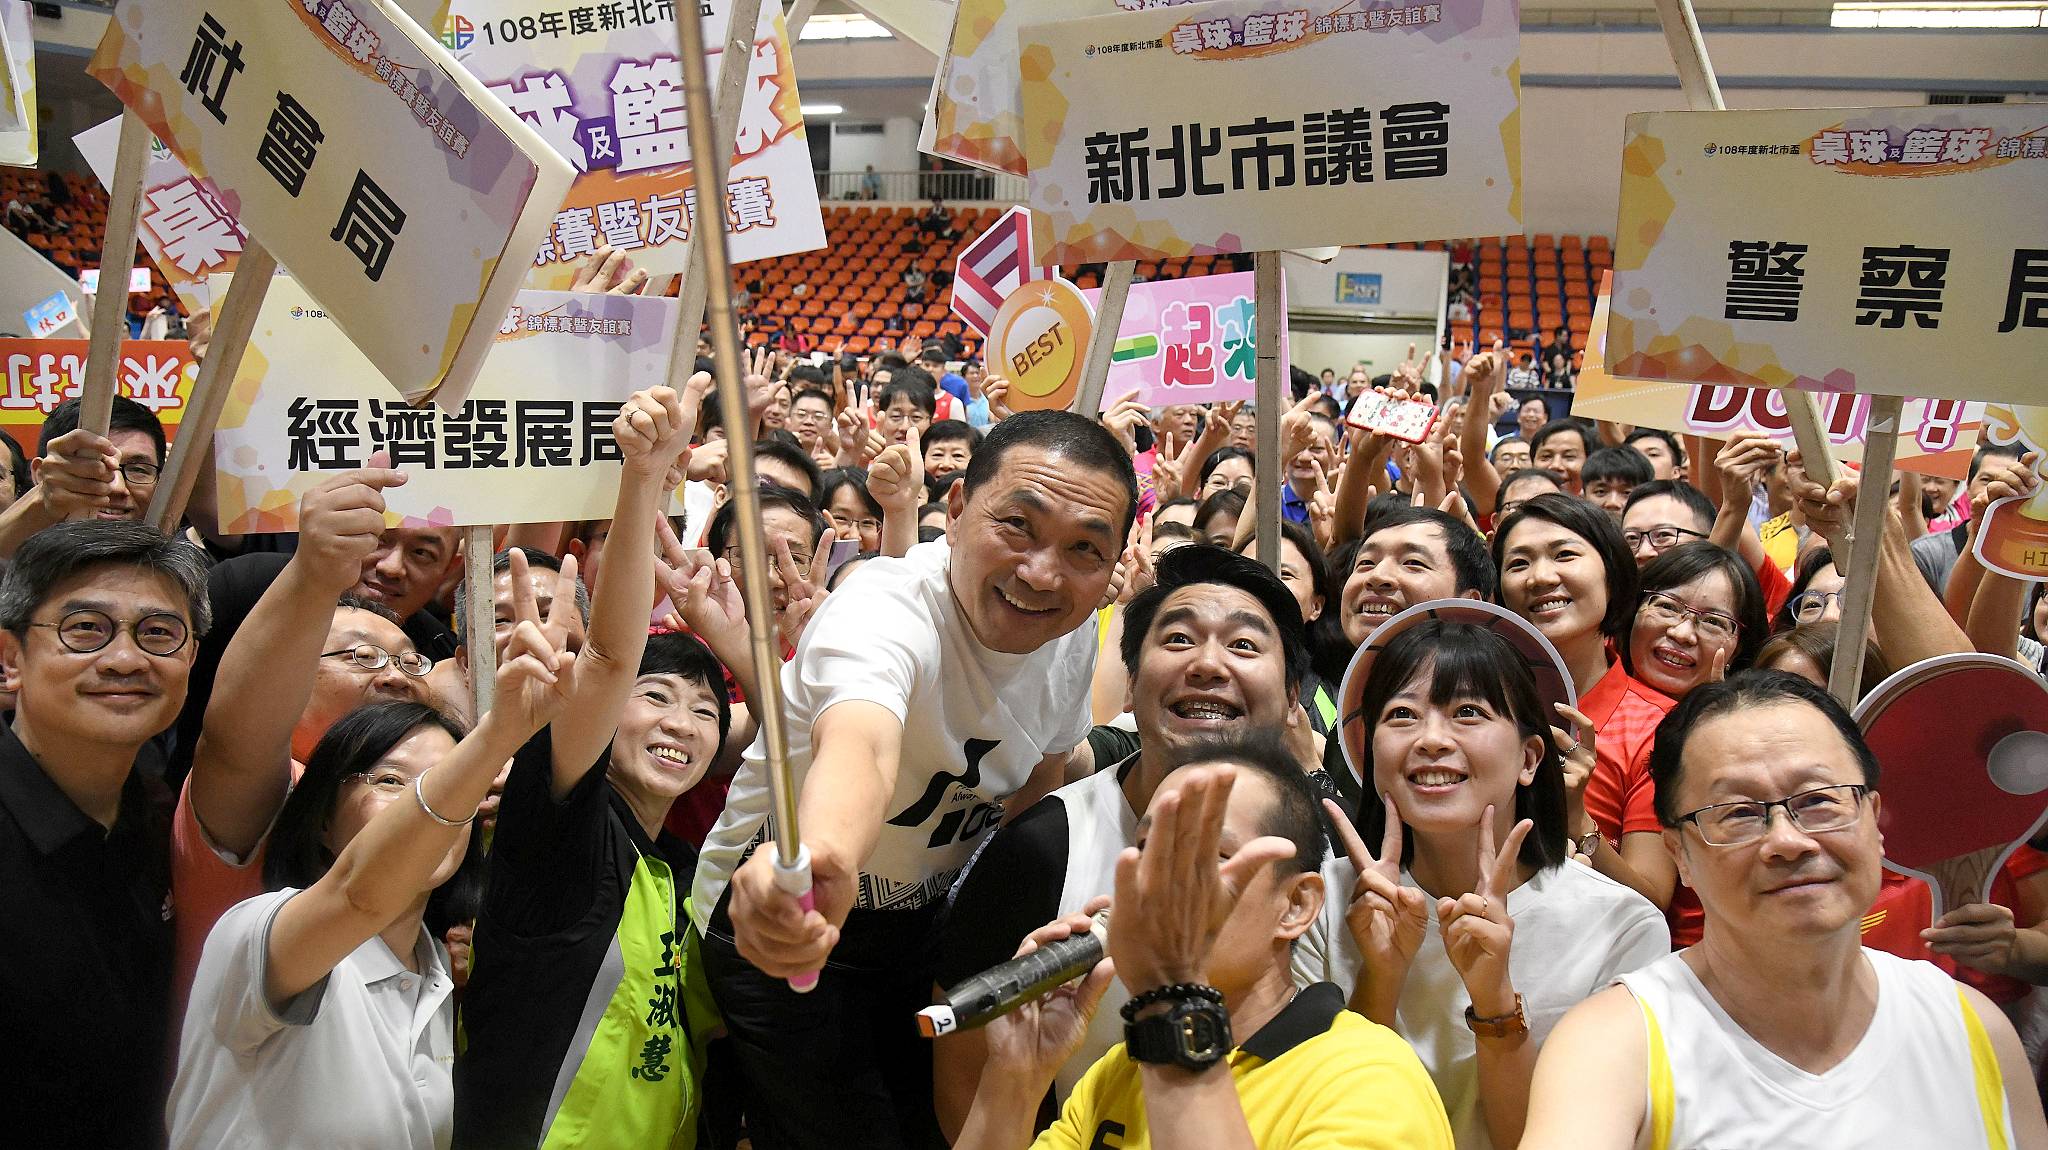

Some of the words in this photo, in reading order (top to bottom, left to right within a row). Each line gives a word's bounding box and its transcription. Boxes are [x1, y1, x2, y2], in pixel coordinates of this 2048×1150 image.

[482, 0, 714, 46] 108年度新北市
[1098, 39, 1163, 54] 108年度新北市盃
[1171, 11, 1309, 54] 桌球及籃球
[1315, 4, 1441, 33] 錦標賽暨友誼賽
[375, 56, 470, 159] 錦標賽暨友誼賽
[180, 12, 407, 282] 社會局
[1085, 101, 1450, 204] 新北市議會
[1719, 144, 1800, 156] 108年度新北市盃
[1812, 129, 1992, 164] 桌球及籃球
[534, 178, 777, 265] 賽暨友賽
[528, 315, 631, 335] 錦標賽暨友誼賽
[1012, 321, 1065, 377] BEST
[287, 397, 624, 471] 經濟發展局
